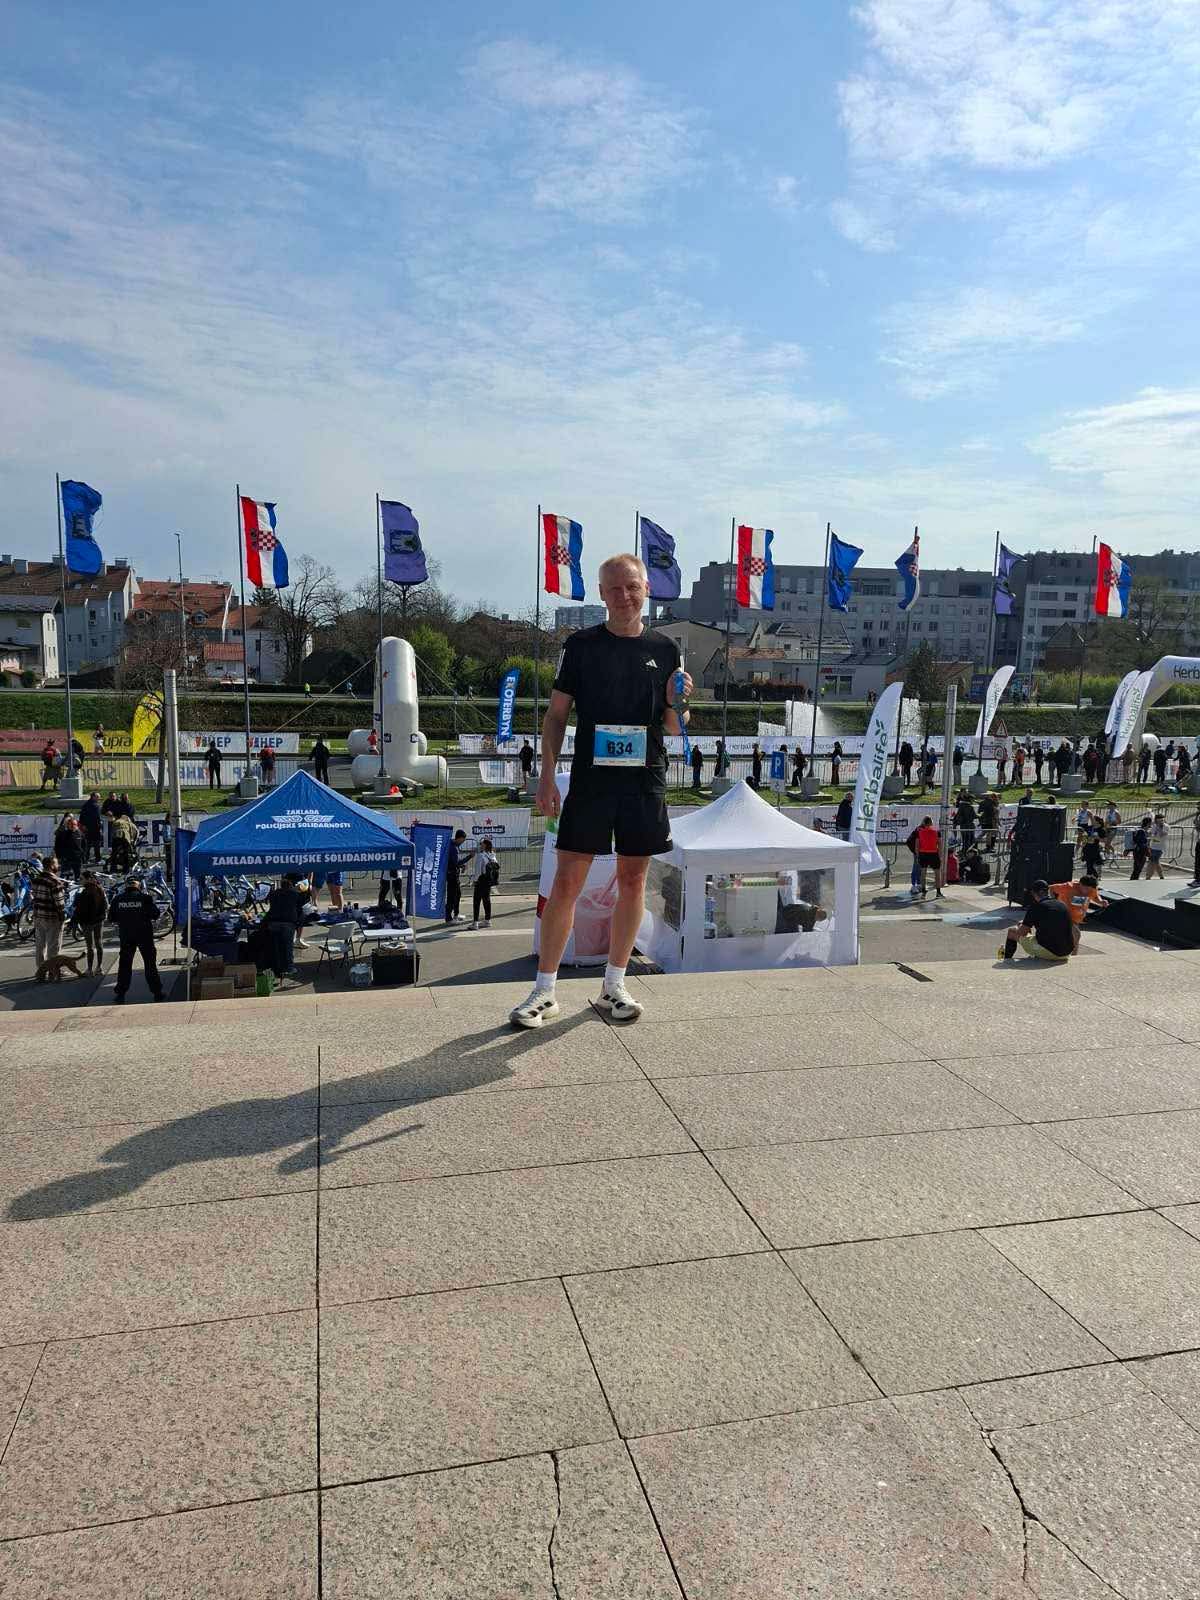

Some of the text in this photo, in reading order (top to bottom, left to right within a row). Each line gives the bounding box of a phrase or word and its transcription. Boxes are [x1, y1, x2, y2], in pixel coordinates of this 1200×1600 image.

[607, 741, 633, 755] 634
[856, 733, 888, 833] Herbalife
[255, 822, 296, 830] POLICIJSKE
[212, 853, 396, 866] ZAKLADA POLICIJSKE SOLIDARNOSTI
